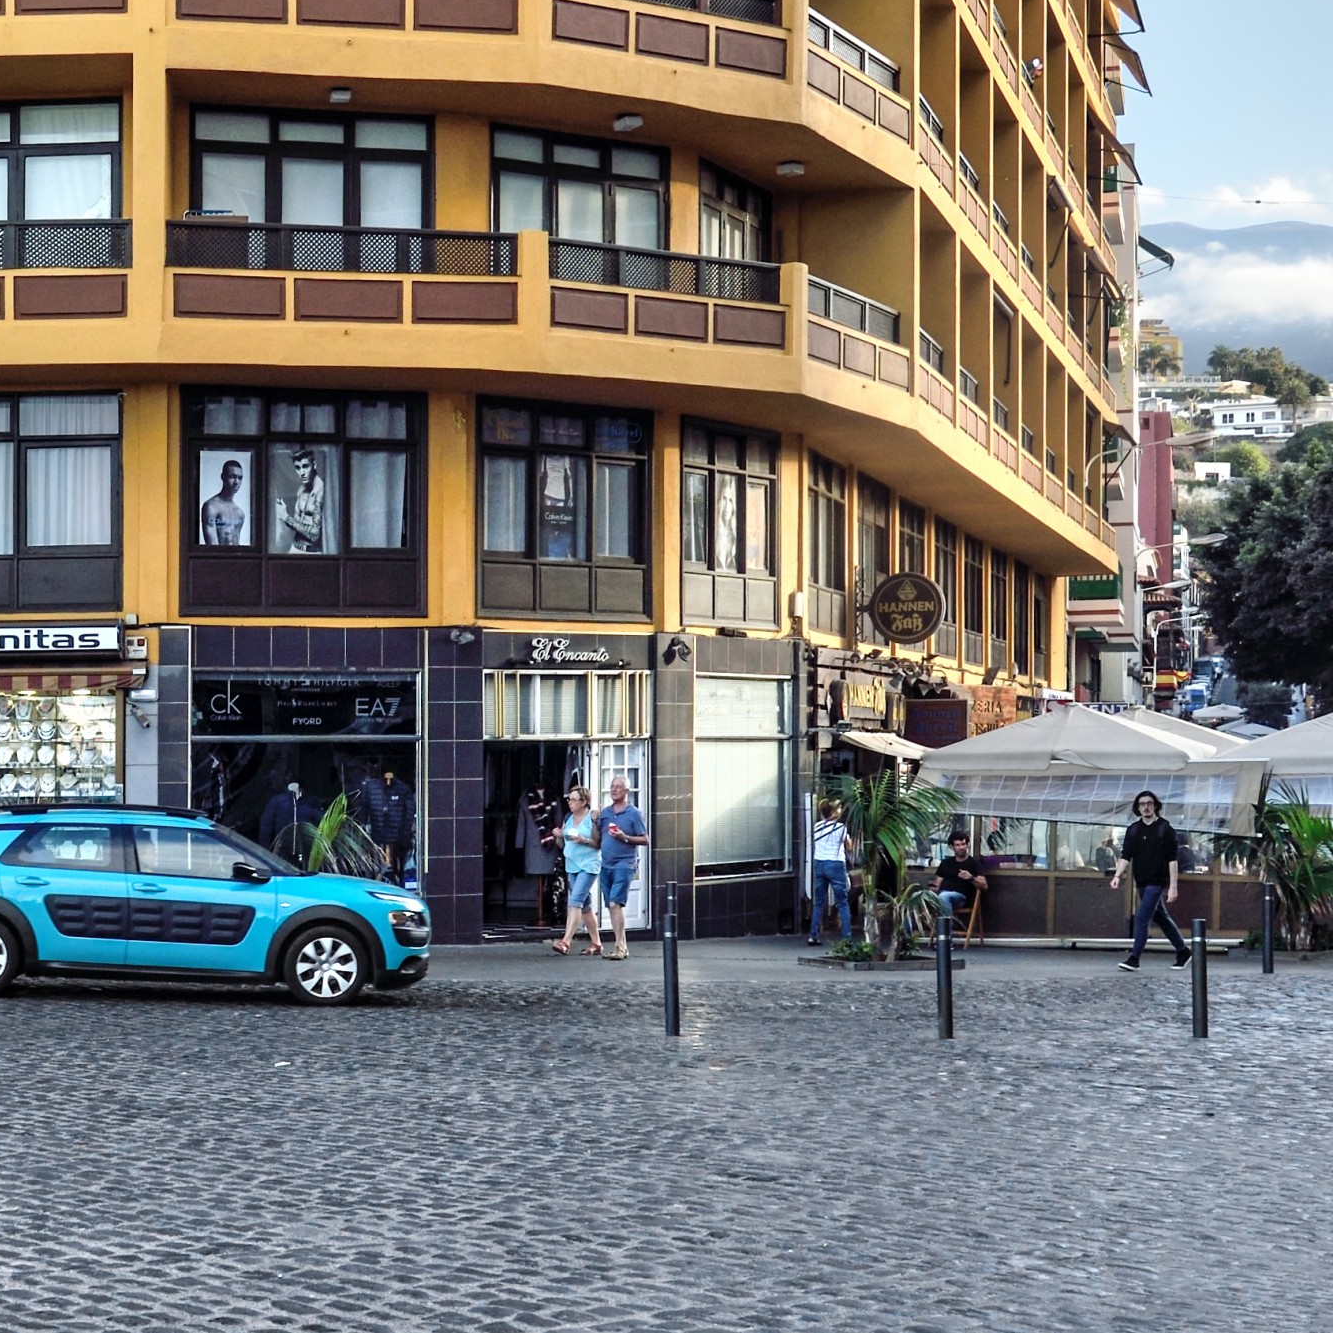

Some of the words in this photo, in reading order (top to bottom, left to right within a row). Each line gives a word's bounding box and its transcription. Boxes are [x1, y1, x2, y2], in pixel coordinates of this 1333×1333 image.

[878, 601, 934, 613] HANNEN
[532, 638, 552, 660] El
[552, 639, 610, 663] Encanto
[257, 677, 298, 686] TOMMY
[313, 678, 360, 687] HILFIGER
[355, 697, 401, 716] EA7
